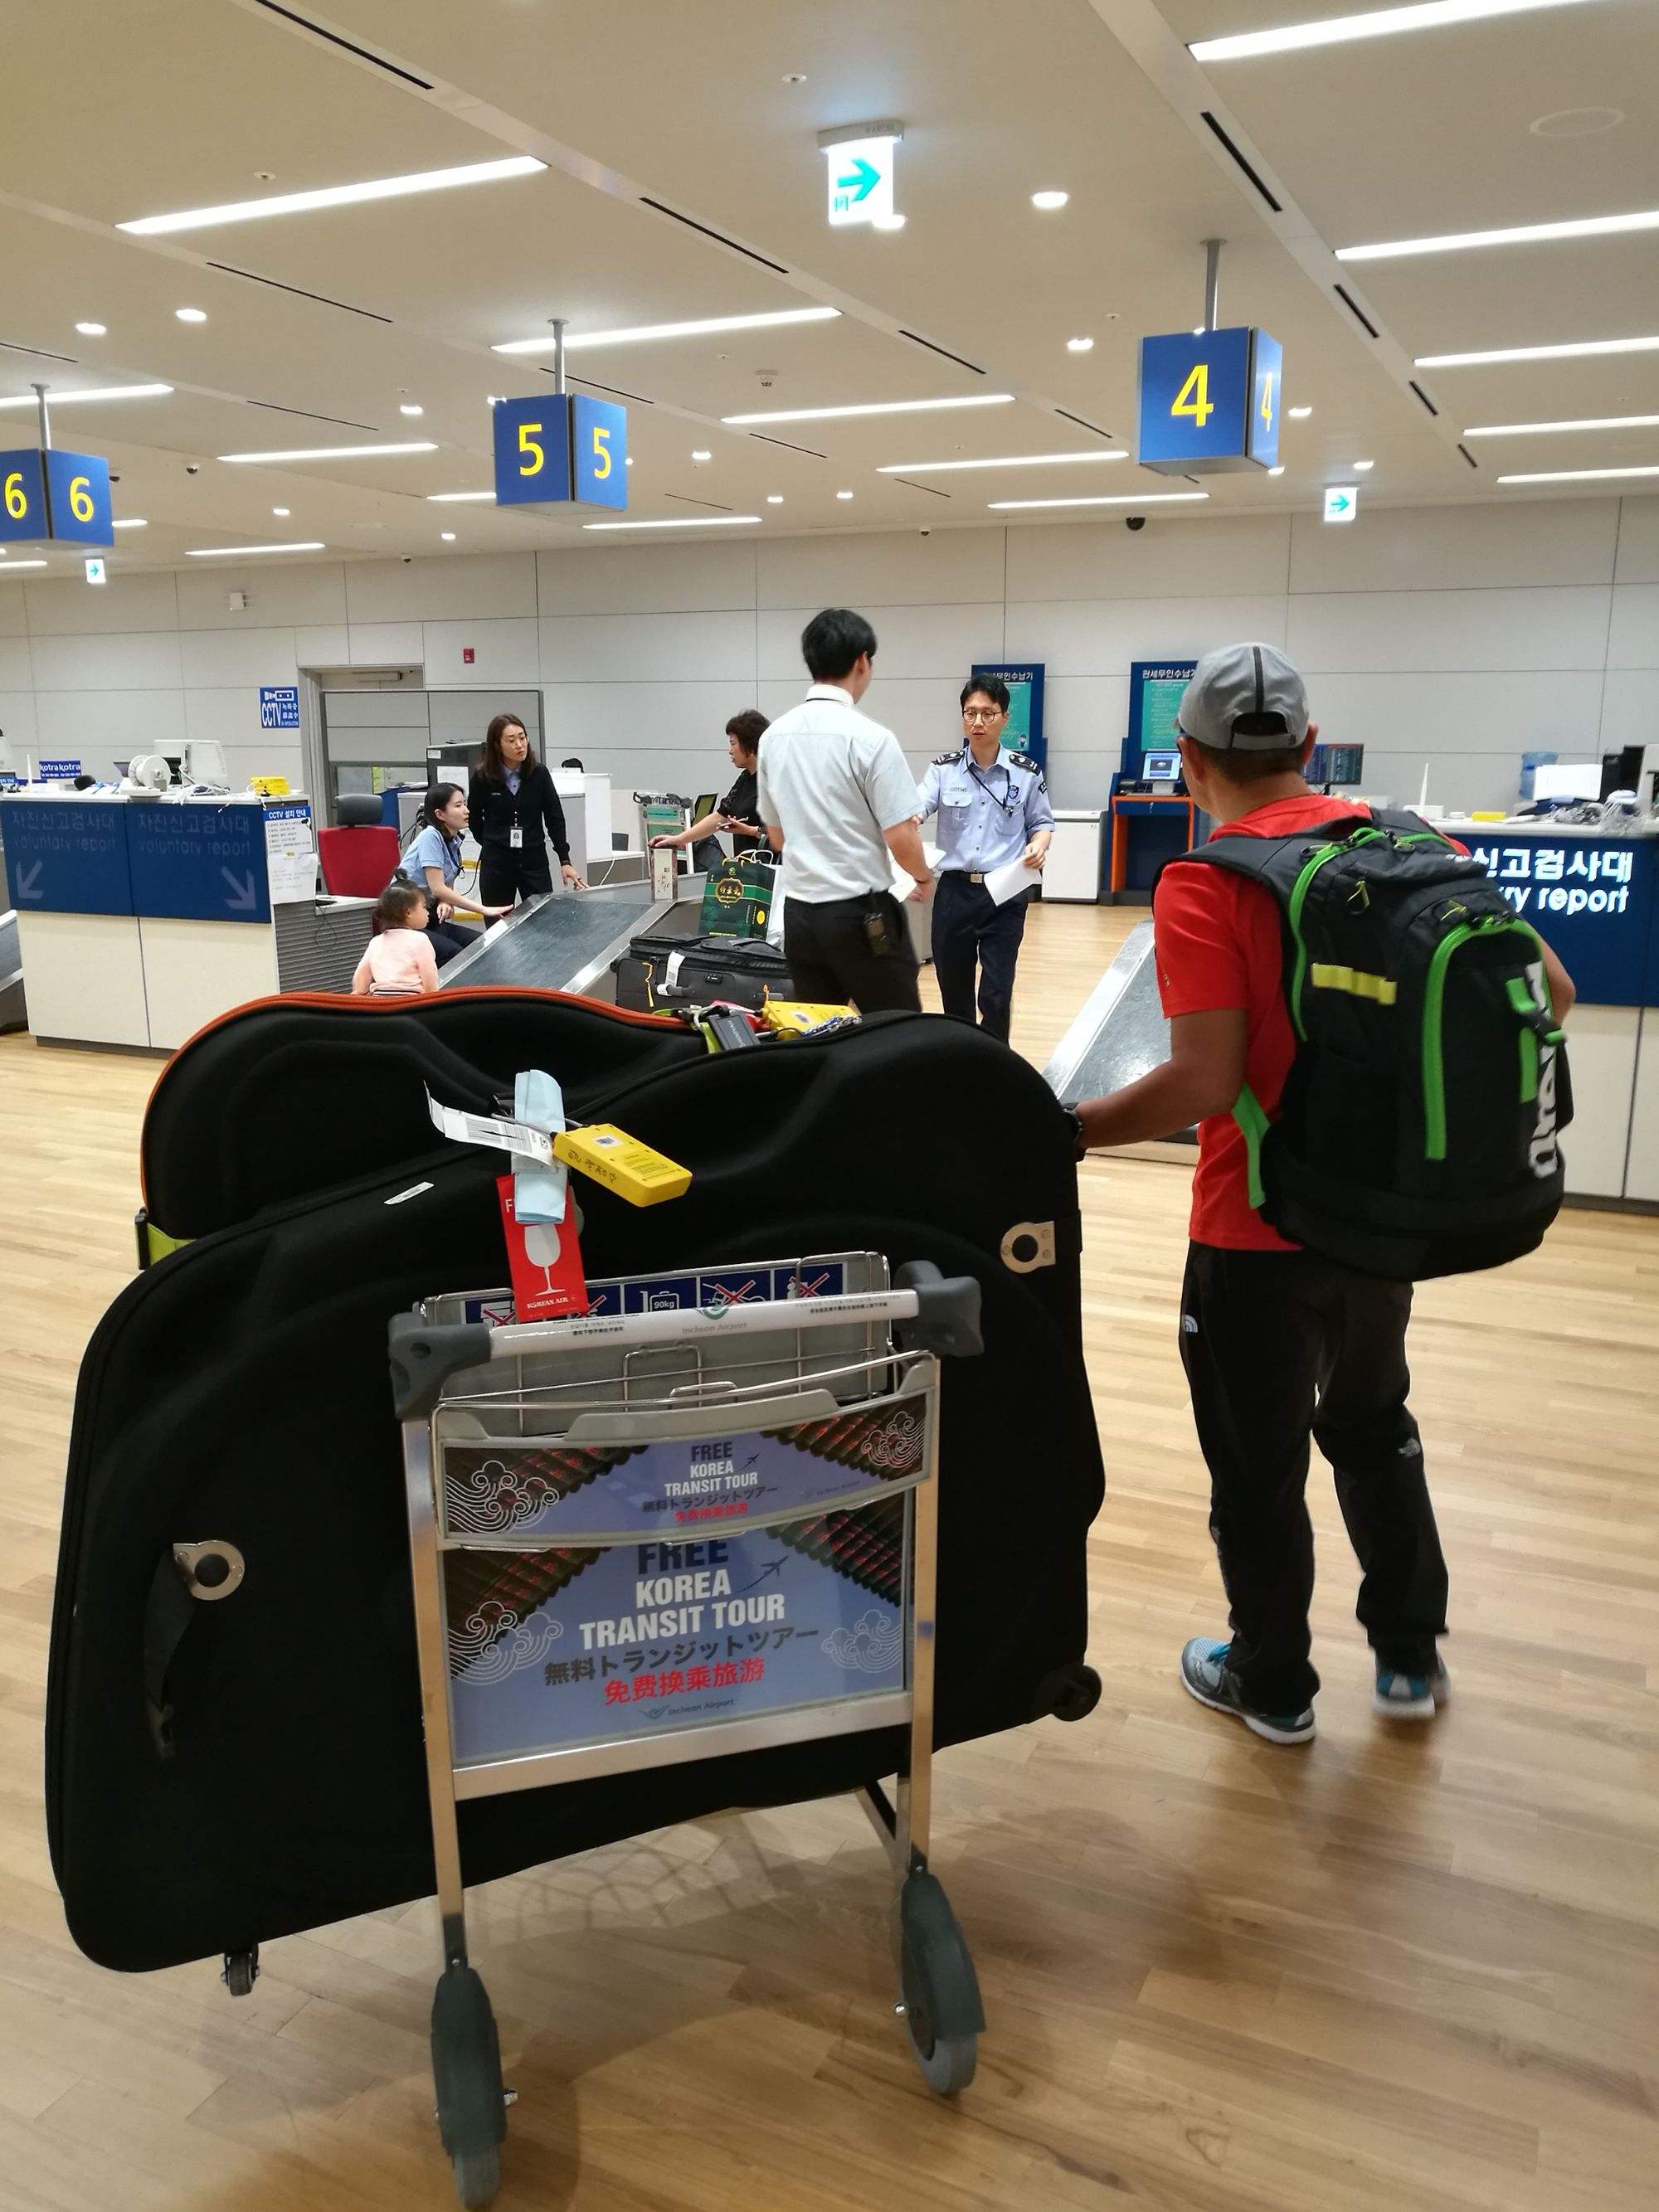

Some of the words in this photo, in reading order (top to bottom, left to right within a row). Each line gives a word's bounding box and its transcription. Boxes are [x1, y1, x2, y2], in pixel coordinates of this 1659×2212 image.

[1171, 364, 1214, 426] 4
[1261, 372, 1272, 432] 4
[518, 424, 544, 476] 5
[593, 427, 611, 479] 5
[5, 473, 27, 518] 6
[70, 477, 94, 522] 6
[993, 672, 1034, 680] 무인수납기
[261, 702, 282, 727] CCTV
[40, 764, 59, 772] kotra
[59, 764, 80, 772] kotra
[12, 811, 115, 831] 자진신고검사대
[138, 813, 250, 835] 자진신고검사대
[269, 811, 284, 819] CCTV
[296, 809, 306, 817] 안내
[139, 838, 202, 855] voluntary
[207, 840, 251, 858] report
[1446, 848, 1633, 882] 신고검사대
[1538, 885, 1629, 916] report
[527, 1299, 555, 1310] KOREAN
[556, 1296, 569, 1305] AIR
[654, 1300, 675, 1309] 90kg
[682, 1325, 716, 1334] Incheon
[718, 1322, 747, 1331] Airport
[691, 1441, 732, 1462] FREE
[690, 1460, 734, 1478] KOREA
[664, 1477, 725, 1496] TRANSIT
[726, 1471, 758, 1490] TOUR
[642, 1486, 778, 1513] 無料トランジットツアー
[638, 1539, 728, 1574] FREE
[635, 1568, 732, 1608] KOREA
[579, 1605, 704, 1650] TRANSIT
[712, 1593, 786, 1629] TOUR
[544, 1626, 819, 1686] 無料トランジットツアー
[604, 1656, 766, 1706] 免费换乘旅游
[669, 1703, 703, 1715] Incheon
[704, 1699, 735, 1713] Airport
